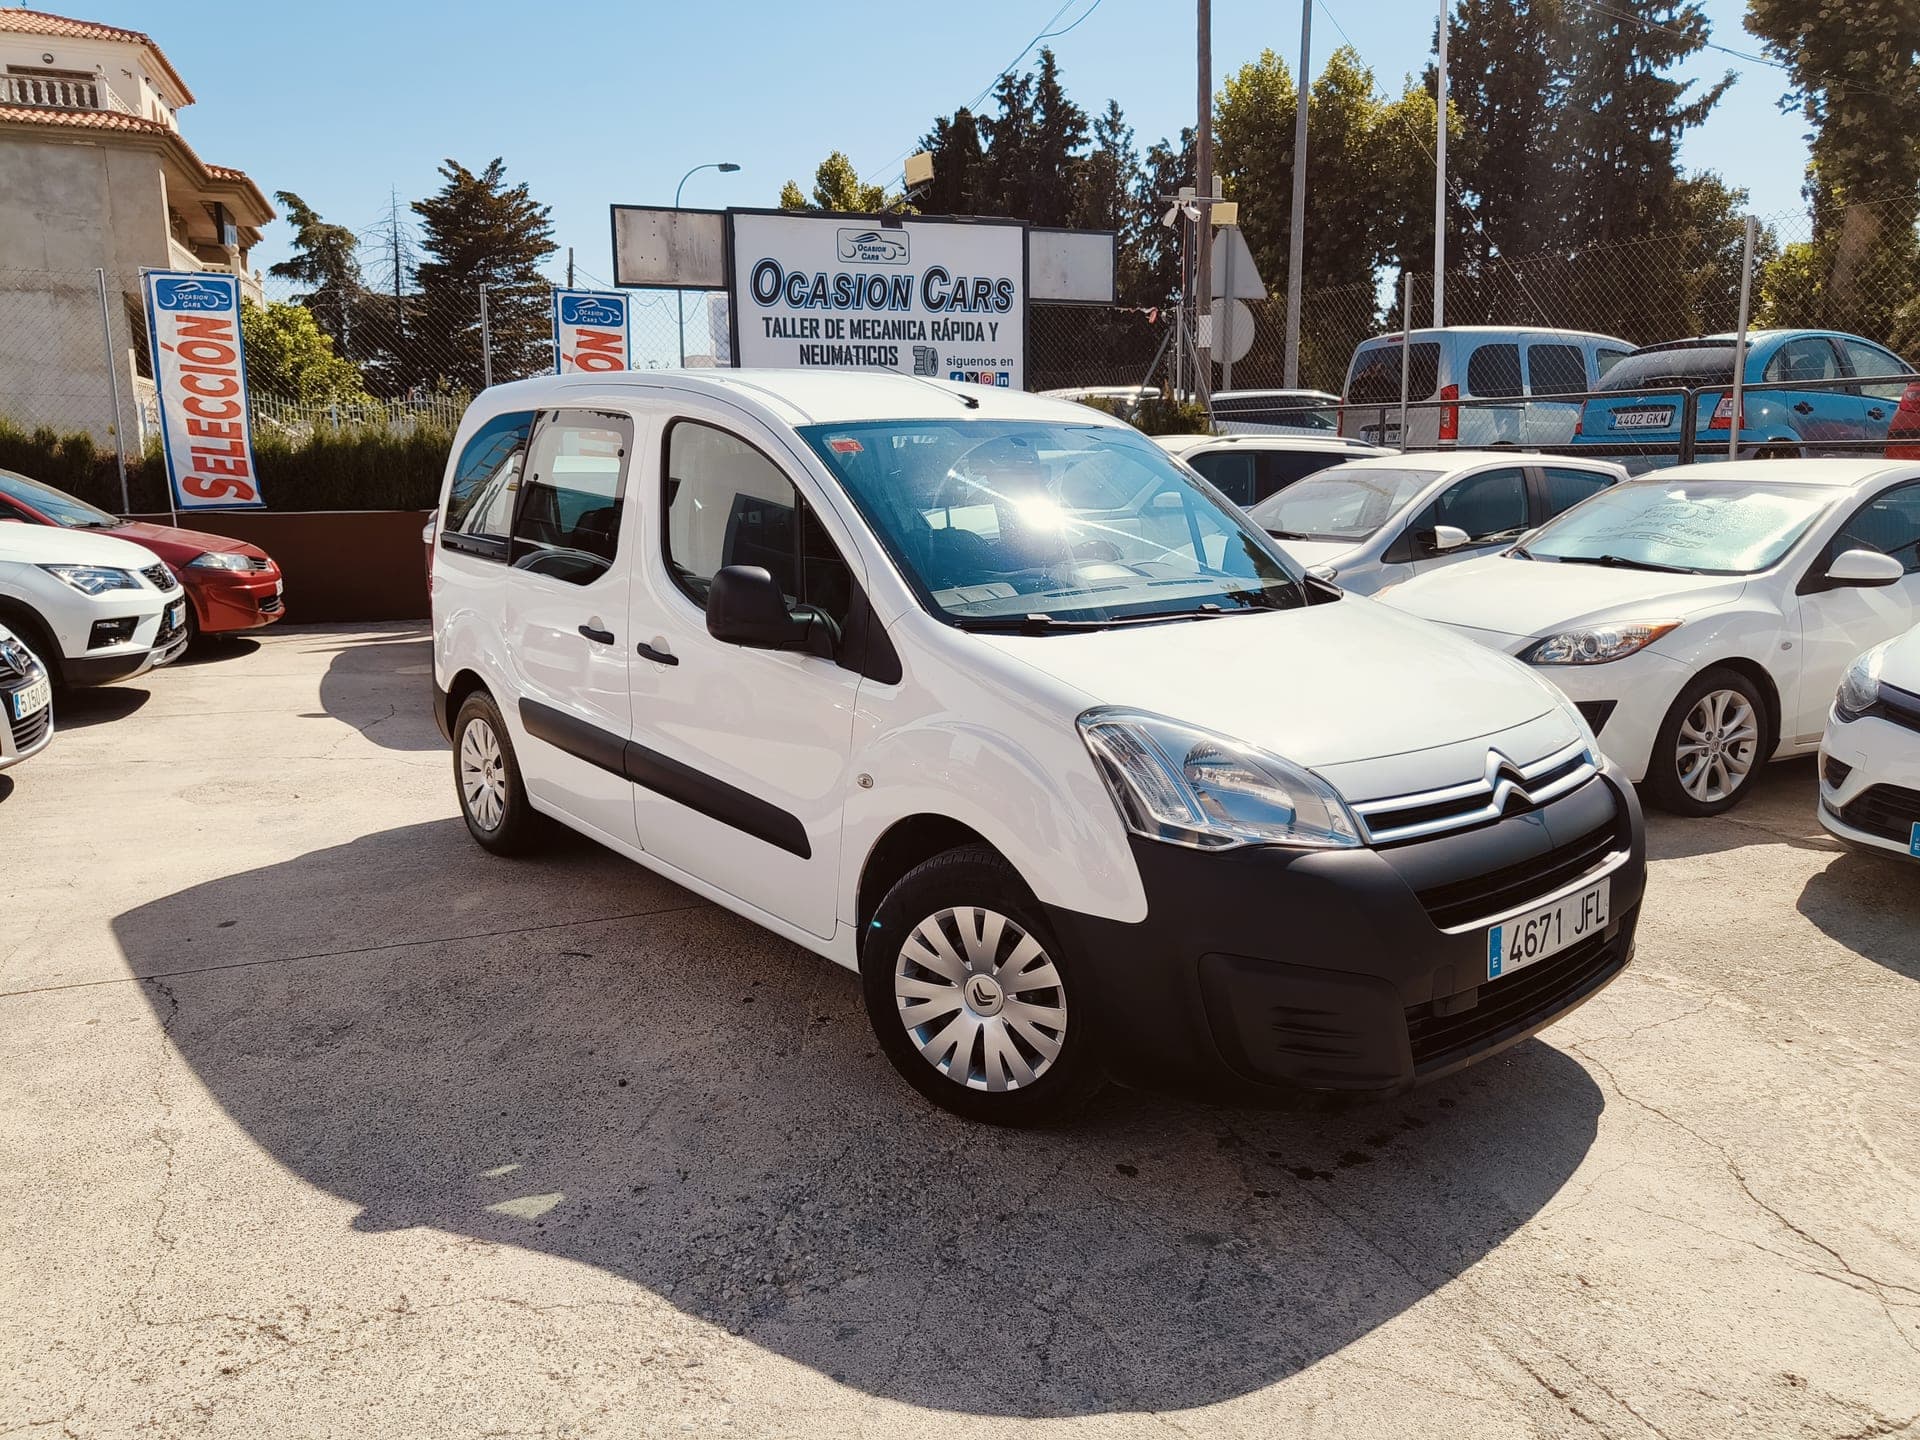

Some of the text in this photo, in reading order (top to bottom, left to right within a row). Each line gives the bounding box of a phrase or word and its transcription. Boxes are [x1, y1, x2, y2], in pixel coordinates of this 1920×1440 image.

[857, 244, 887, 252] OCASION
[750, 258, 1014, 313] OCASION CARS
[762, 317, 999, 342] TALLER DE MECANICA RÁPIDA Y
[799, 344, 899, 366] NEUMATICOS
[1000, 358, 1014, 367] en
[160, 314, 254, 501] SELECCIÓN
[1617, 414, 1644, 426] 4402
[1646, 413, 1668, 424] GKM
[1509, 908, 1563, 963] 4671
[1574, 889, 1605, 935] JFL
